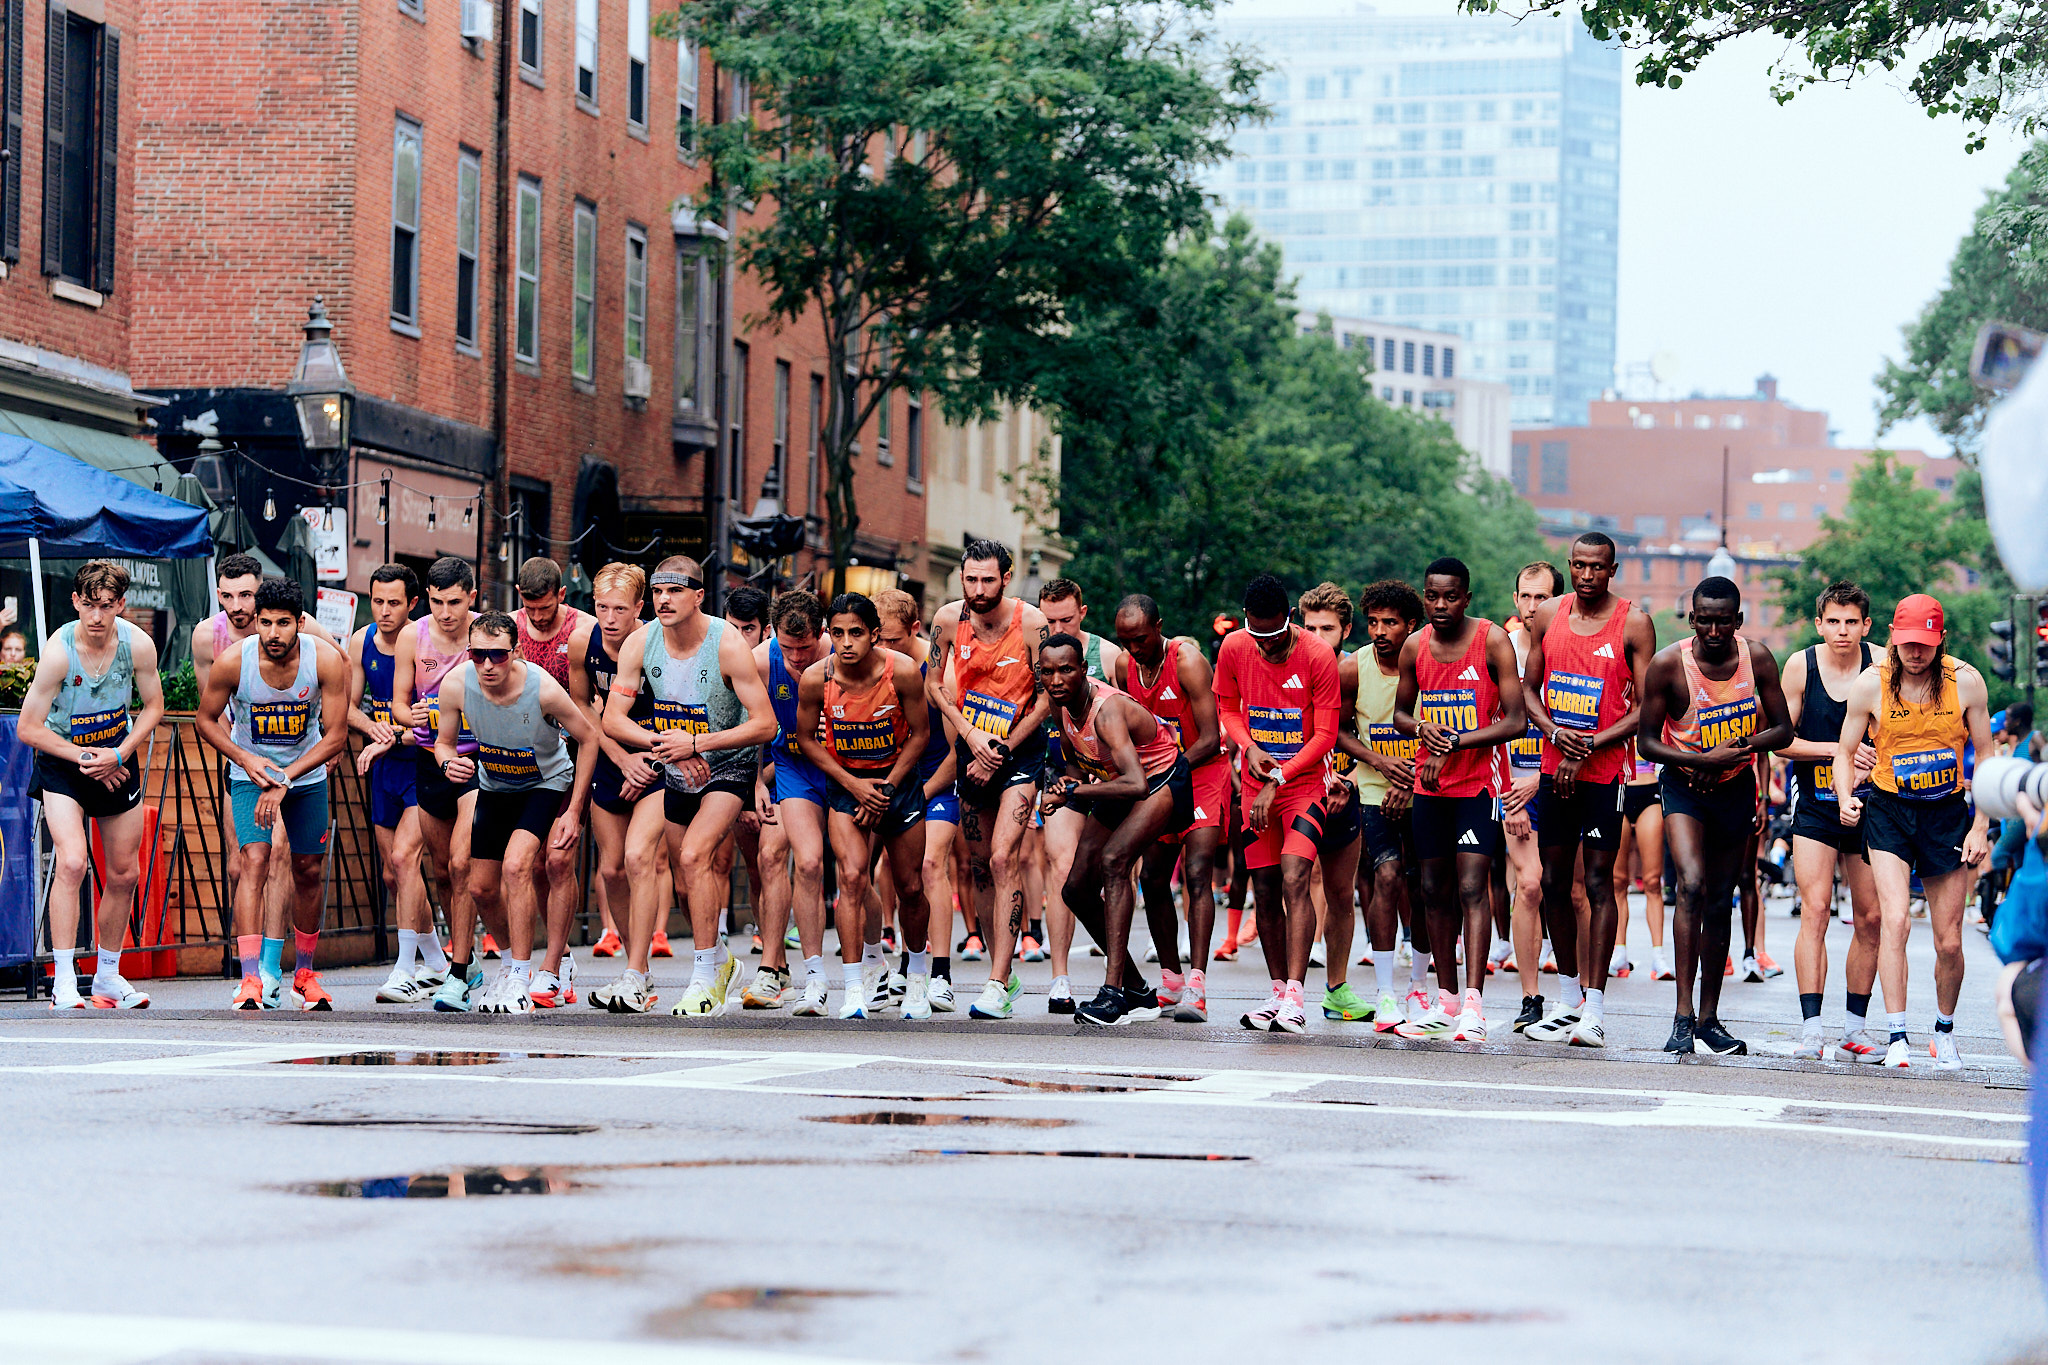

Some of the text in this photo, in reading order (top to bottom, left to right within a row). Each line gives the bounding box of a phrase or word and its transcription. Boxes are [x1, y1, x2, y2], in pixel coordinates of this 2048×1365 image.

[136, 561, 160, 587] HOTEL
[1549, 674, 1602, 689] BOSTON 10K
[966, 693, 1015, 715] BOSTON 10K
[1422, 691, 1474, 702] BOSTON 10K
[1547, 689, 1599, 717] GABRIEL
[71, 707, 125, 726] BOSTON 10K
[251, 703, 308, 713] BOSTON 10K
[689, 706, 706, 715] 10K
[1249, 709, 1301, 721] BOSTON 10K
[1699, 701, 1755, 721] BOSTON 10K
[1890, 709, 1910, 719] ZAP
[833, 719, 890, 731] BOSTON 10K
[961, 705, 1012, 740] FLAVIN
[1701, 713, 1757, 749] MASAI
[835, 733, 894, 751] ALJABALY
[480, 745, 533, 758] BOSTON 10K
[1893, 751, 1954, 767] BOSTON 10K
[1911, 767, 1956, 790] COLLEY
